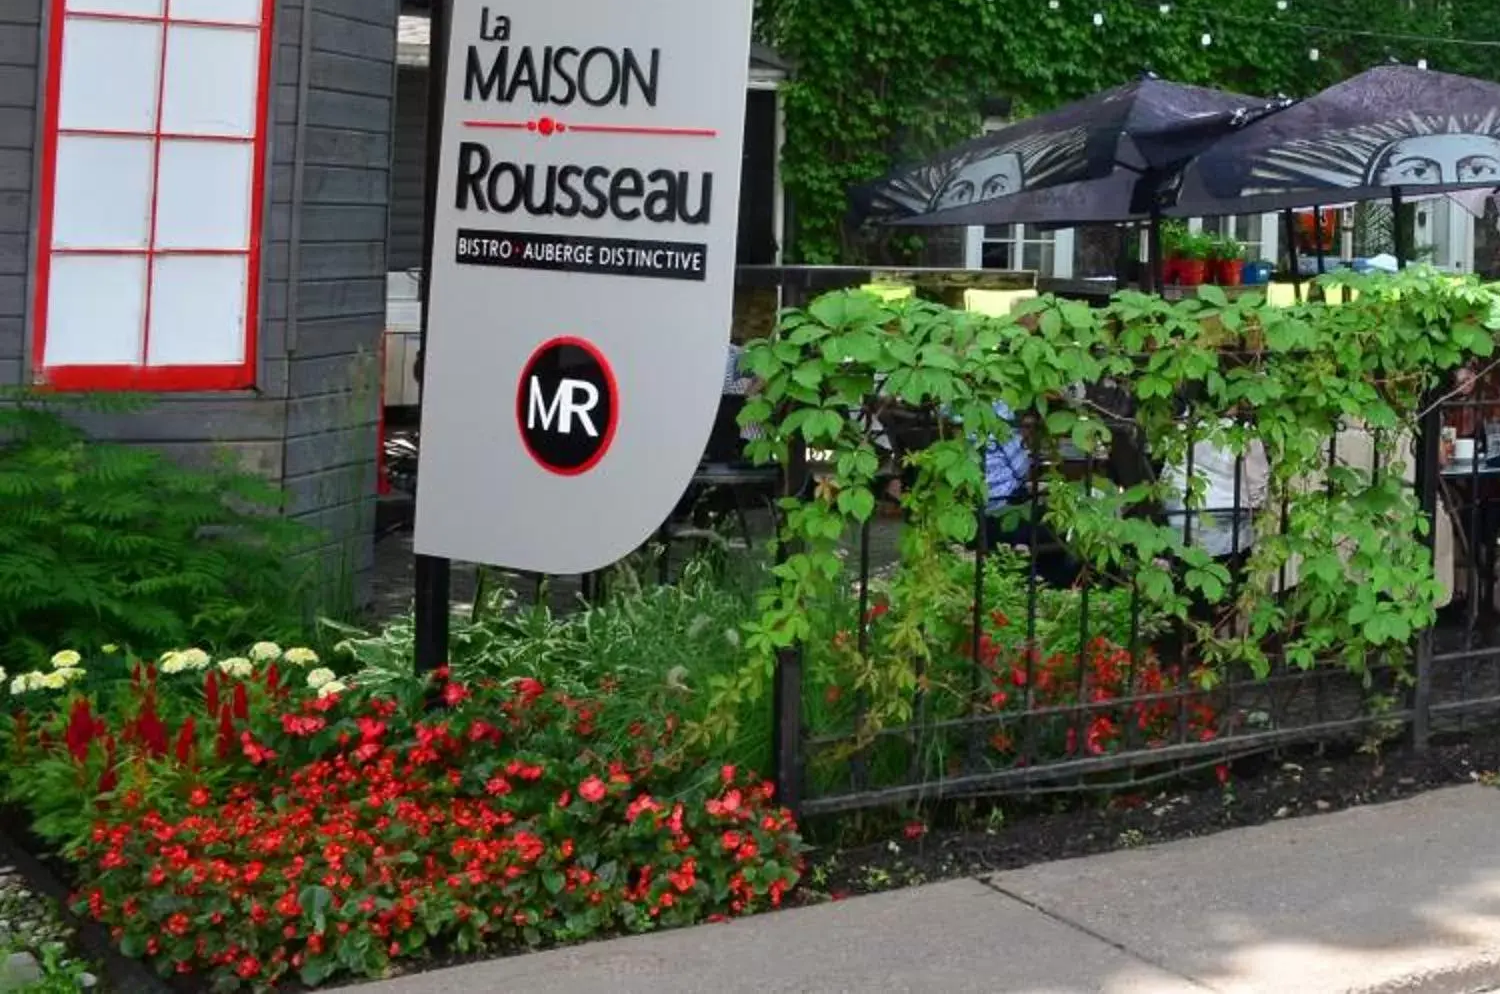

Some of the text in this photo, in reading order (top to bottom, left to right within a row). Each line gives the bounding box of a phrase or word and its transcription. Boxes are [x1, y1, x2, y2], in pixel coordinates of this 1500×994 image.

[479, 6, 511, 41] La
[463, 45, 660, 108] MAISON
[455, 141, 713, 225] Rousseau
[457, 236, 702, 272] BISTRO AUBERGE DISTINCTIVE
[527, 375, 600, 438] MR
